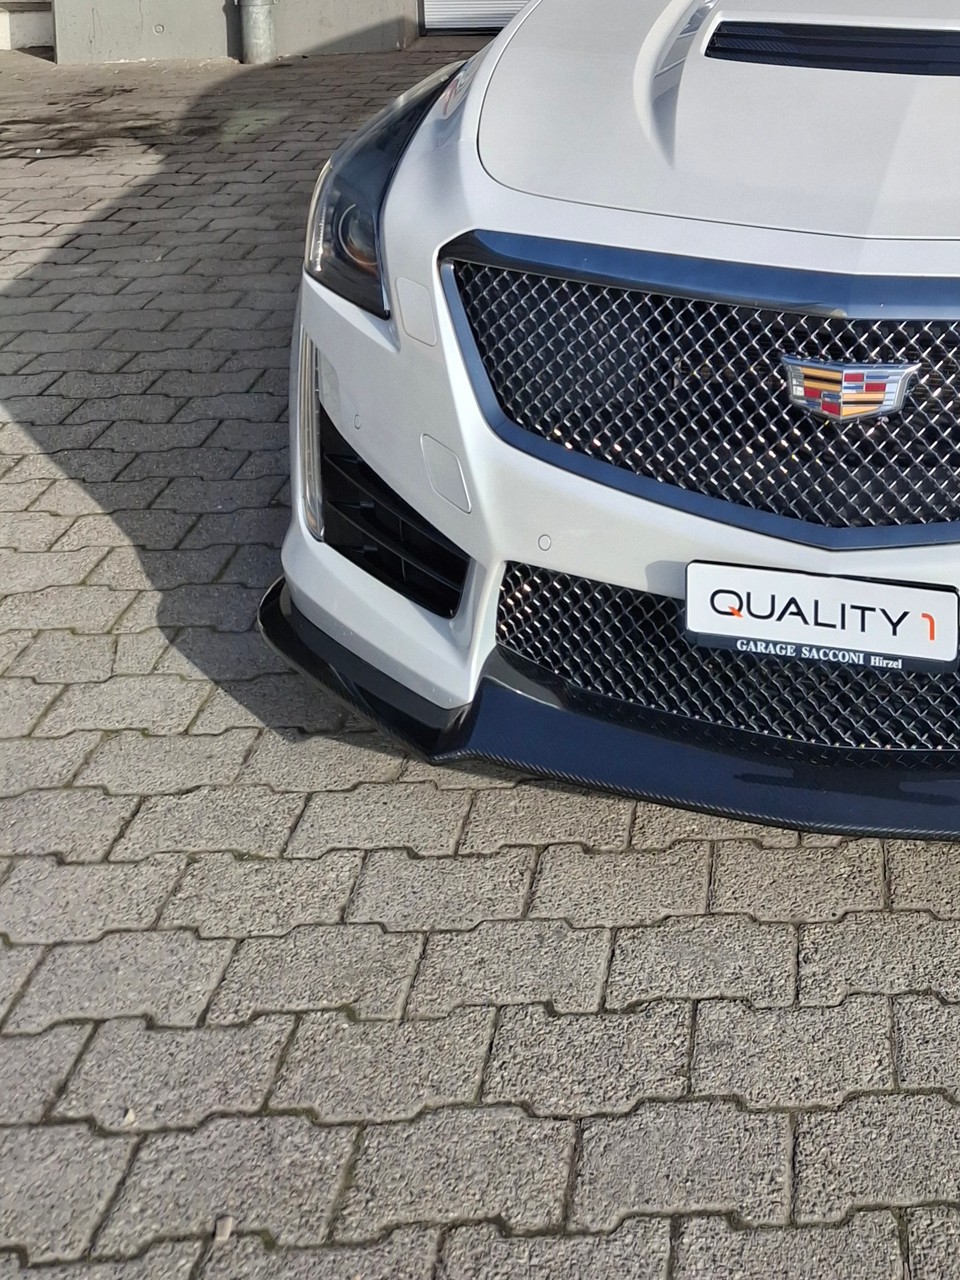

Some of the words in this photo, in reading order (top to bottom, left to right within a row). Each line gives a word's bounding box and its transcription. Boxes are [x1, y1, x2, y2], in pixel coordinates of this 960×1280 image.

[736, 639, 796, 657] GARAGE
[801, 646, 864, 665] SACCONI
[870, 655, 902, 670] Hirzel
